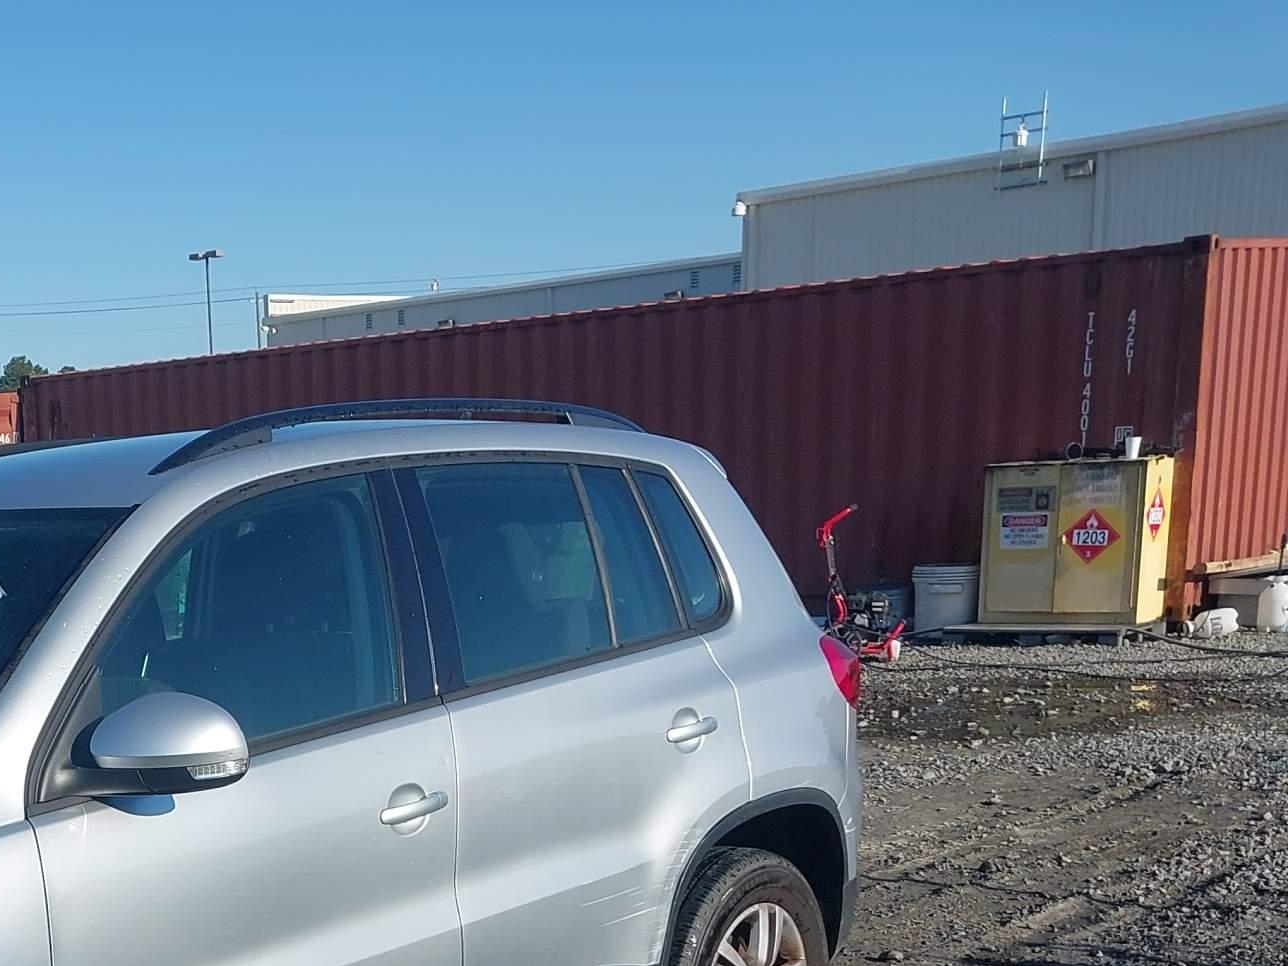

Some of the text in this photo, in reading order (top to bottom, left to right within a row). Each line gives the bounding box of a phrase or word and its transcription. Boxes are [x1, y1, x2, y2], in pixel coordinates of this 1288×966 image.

[1083, 312, 1095, 378] TCLU
[1125, 309, 1137, 375] 42G1
[1074, 531, 1107, 545] 1203
